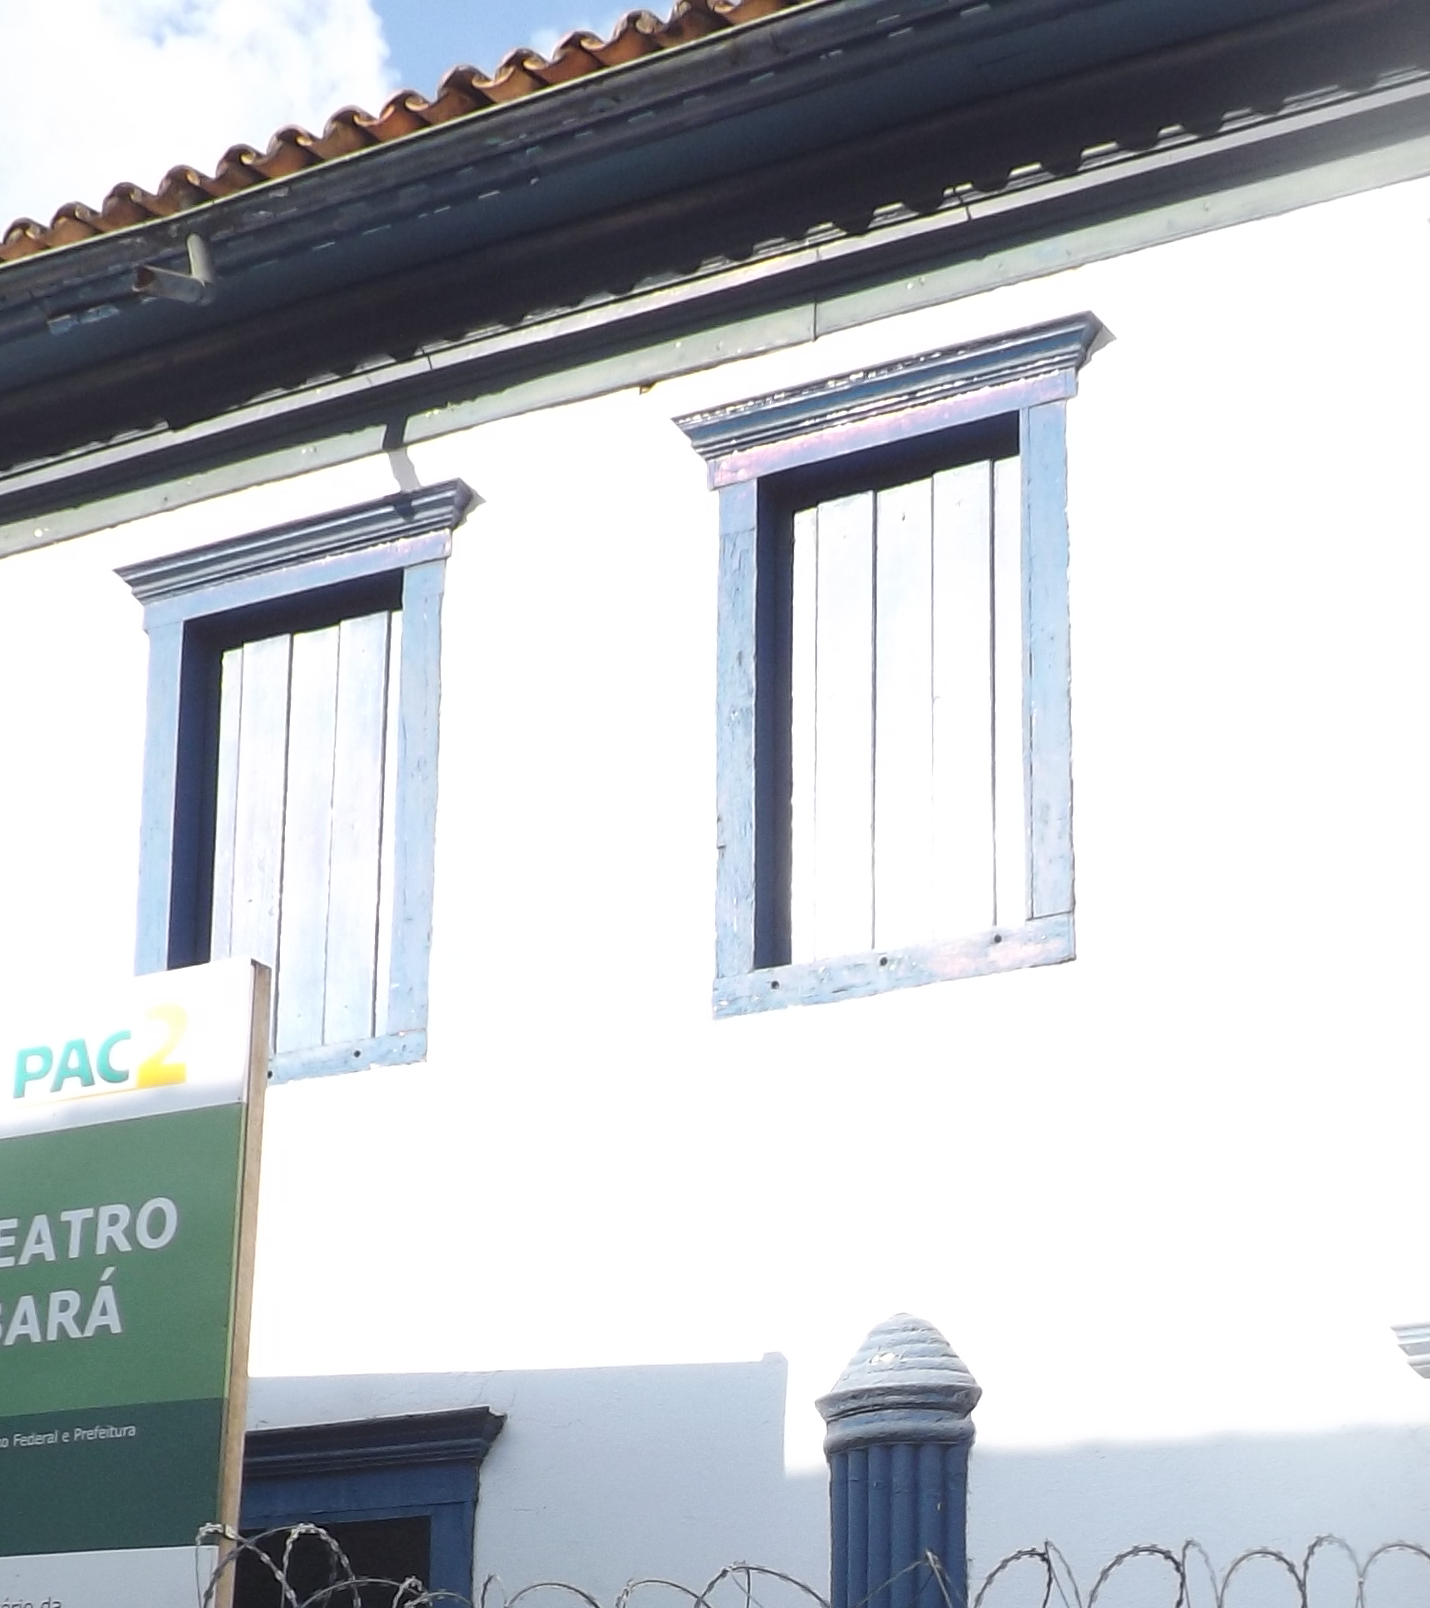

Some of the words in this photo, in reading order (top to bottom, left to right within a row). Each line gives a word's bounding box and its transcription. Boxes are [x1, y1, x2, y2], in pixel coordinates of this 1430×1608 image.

[13, 1429, 59, 1447] Federal
[61, 1433, 71, 1444] e
[73, 1423, 137, 1442] Prefeitura
